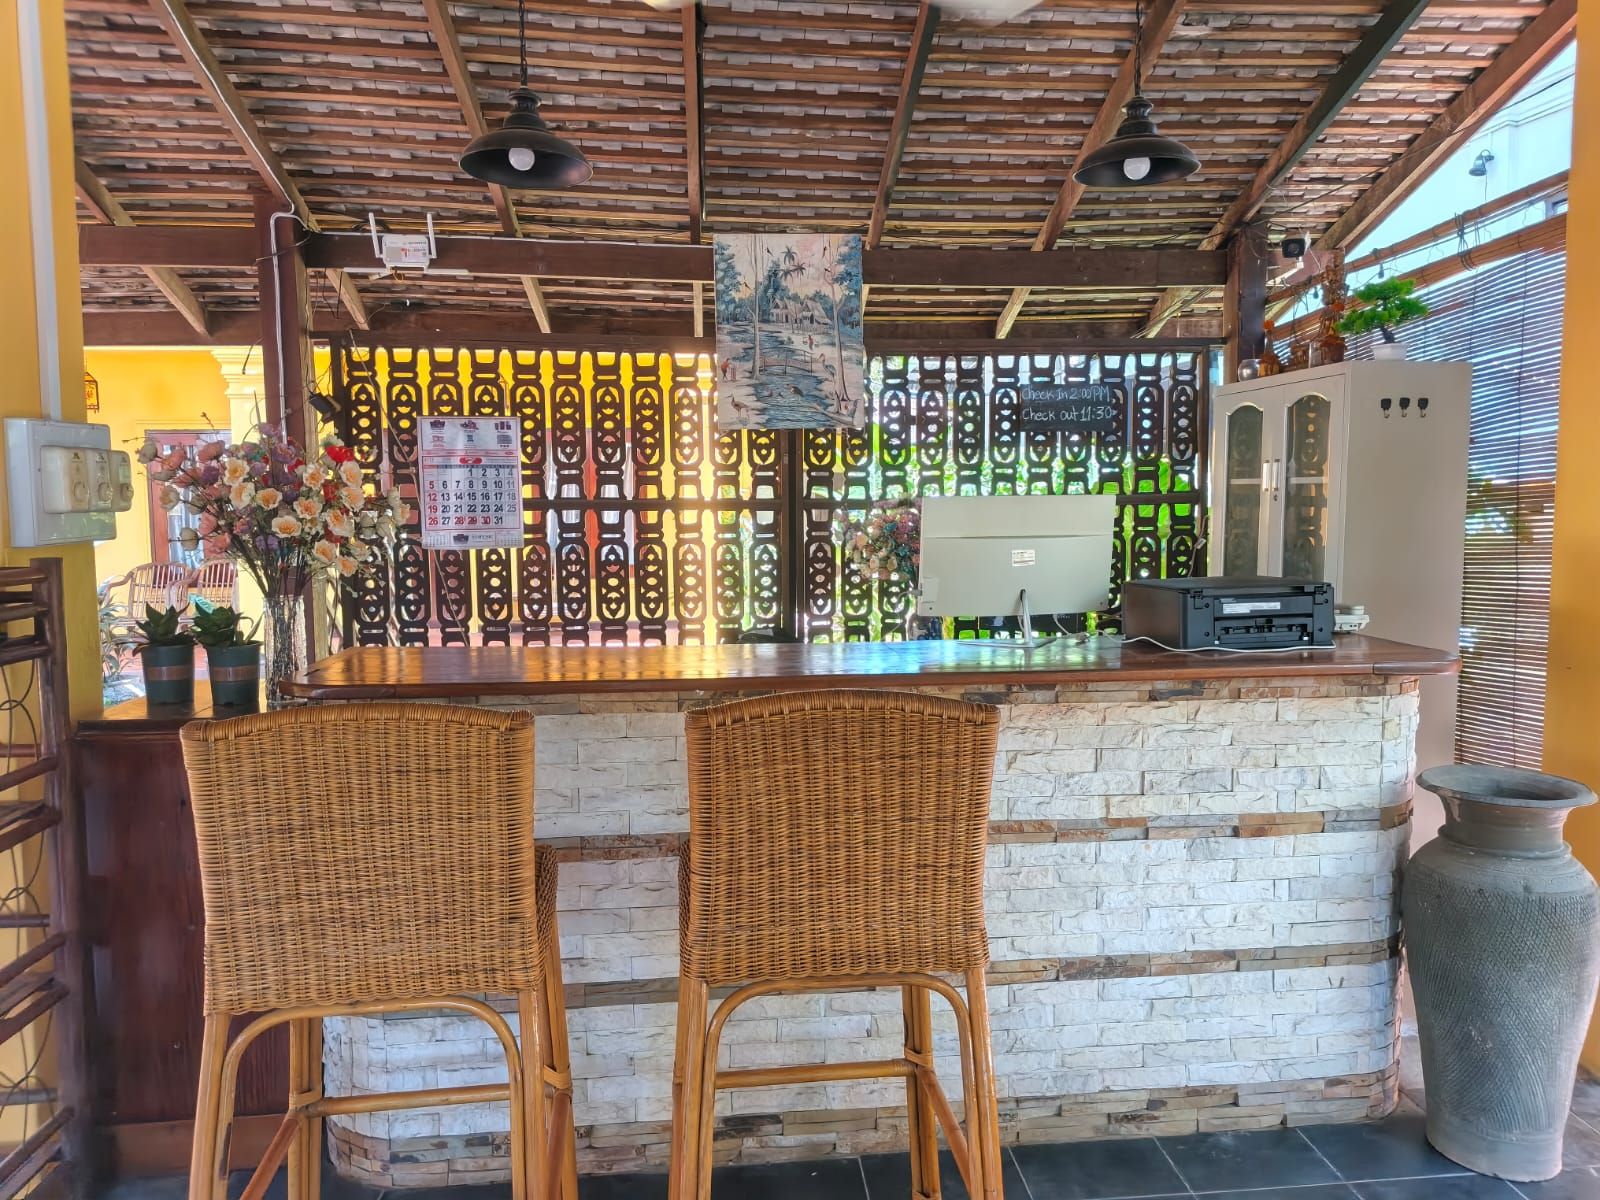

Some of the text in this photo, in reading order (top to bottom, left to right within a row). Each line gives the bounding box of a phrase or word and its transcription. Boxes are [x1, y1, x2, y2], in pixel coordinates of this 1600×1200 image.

[1022, 387, 1054, 400] Check
[1055, 388, 1068, 400] In
[1022, 405, 1112, 422] Check out 11:30
[468, 468, 473, 476] 1
[481, 468, 487, 476] 2
[495, 468, 500, 476] 3
[429, 481, 434, 489] 5
[442, 481, 447, 489] 6
[493, 481, 502, 489] 10
[441, 493, 450, 501] 13
[428, 505, 437, 513] 19
[441, 505, 450, 513] 20
[494, 504, 503, 512] 24
[507, 504, 516, 512] 25
[428, 516, 503, 525] 26 27 28 29 30 31
